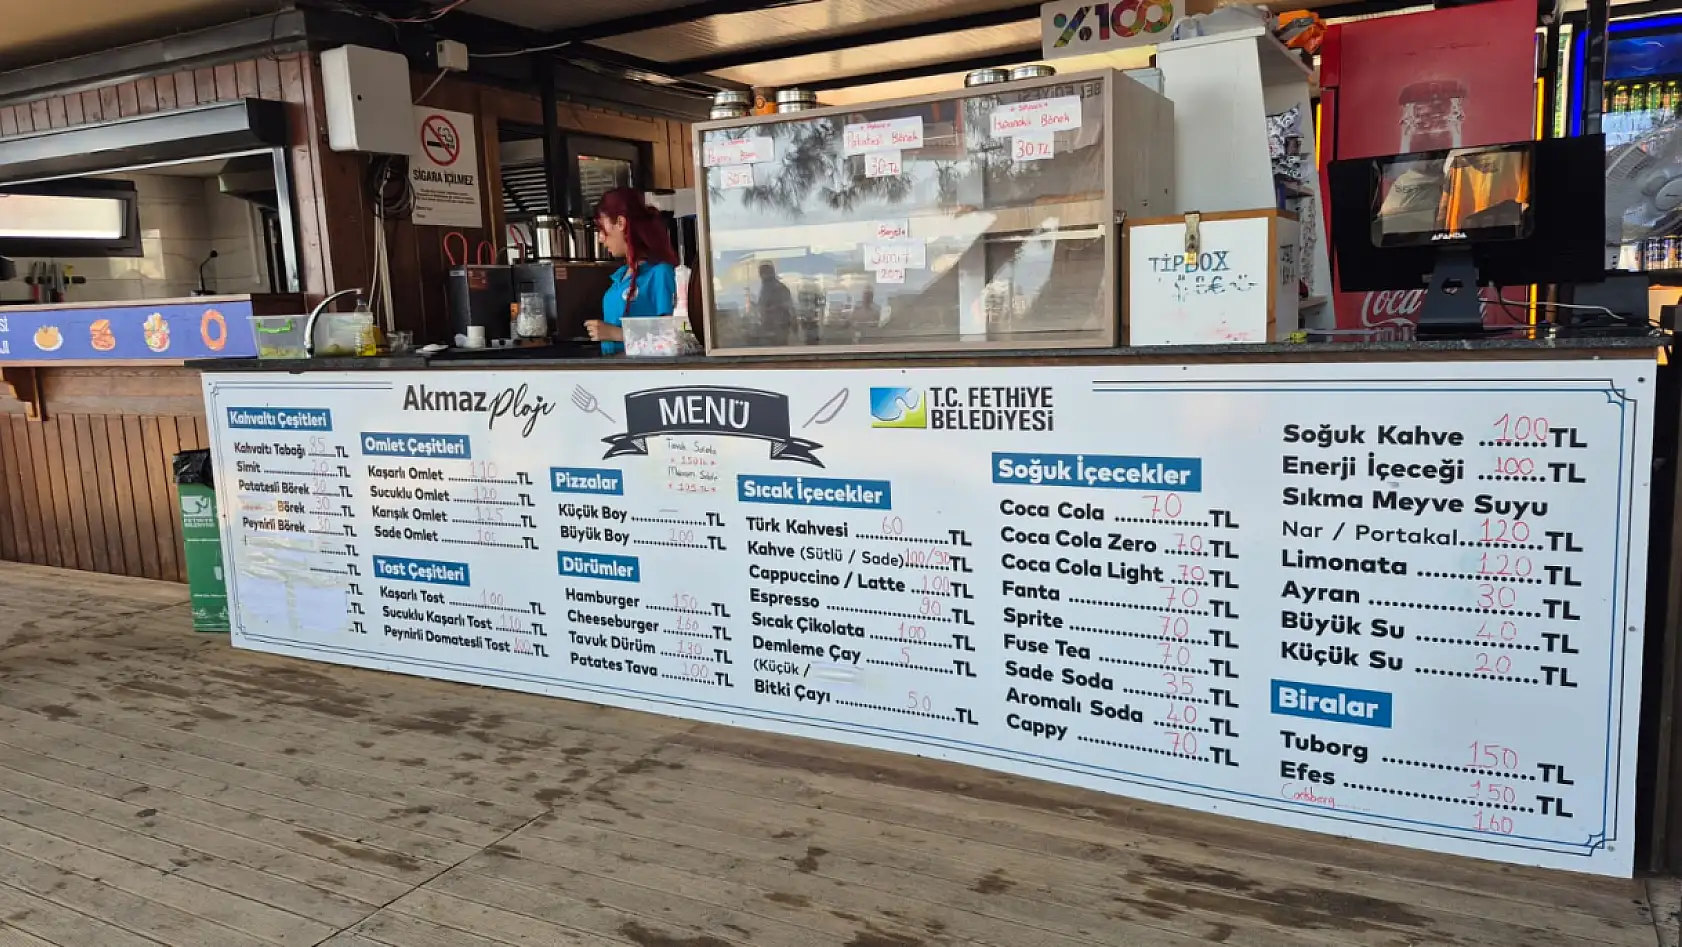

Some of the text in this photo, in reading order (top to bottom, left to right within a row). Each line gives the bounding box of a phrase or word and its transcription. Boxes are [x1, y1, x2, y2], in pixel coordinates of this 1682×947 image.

[1053, 0, 1174, 47] %100
[1017, 139, 1034, 159] 30
[403, 384, 487, 413] Akmaz
[930, 387, 962, 408] T.C.
[230, 410, 327, 429] Kahvaltı Çeşitleri
[658, 395, 750, 429] MENÜ
[1282, 413, 1588, 448] Soğuk Kahve 100 TL
[233, 441, 272, 455] Kahvaltı
[335, 445, 349, 458] TL
[364, 436, 464, 457] Omlet Çeşitleri
[236, 460, 261, 473] Simit
[368, 464, 445, 481] Kaşarlı Omlet
[999, 455, 1191, 486] Soğuk İçecekler
[1281, 451, 1535, 484] Enerji İçeceği 100
[238, 479, 310, 495] Patatesli Börek
[370, 485, 451, 502] Sucuklu Omlet
[555, 471, 619, 491] Pizzalar
[743, 477, 883, 504] Sıcak İçecekler
[277, 500, 305, 514] Börek
[372, 504, 449, 523] Karışık Omlet
[558, 502, 628, 523] Küçük Boy
[999, 493, 1240, 529] Coca Cola 70 TL
[1282, 486, 1549, 520] Sıkma Meyve Suyu
[278, 519, 306, 533] Börek
[374, 525, 440, 542] Sade Omlet
[560, 525, 631, 546] Büyük Boy
[746, 515, 973, 547] Türk Kahvesi 60 TL
[1000, 525, 1203, 553] Coca Cola Zero 70
[1282, 518, 1530, 546] Nar Portakal 120
[345, 543, 360, 557] TL
[747, 540, 796, 557] Kahve
[800, 546, 843, 562] (Sütlü
[861, 551, 905, 568] Sade)
[1281, 549, 1533, 577] Limonata 120
[376, 559, 464, 582] Tost Çeşitleri
[562, 556, 634, 578] Dürümler
[749, 564, 841, 585] Cappuccino
[857, 573, 906, 593] Latte
[1001, 553, 1205, 585] Coca Cola Light 70
[380, 585, 547, 616] Kaşarlı Tost TL
[565, 587, 641, 609] Hamburger
[749, 588, 820, 608] Espresso
[1002, 580, 1200, 609] Fanta 70
[1281, 580, 1516, 608] Ayran 30
[382, 605, 493, 631] Sucuklu Kaşarlı Tost
[567, 609, 660, 635] Cheeseburger
[751, 612, 794, 630] Sıcak
[796, 616, 866, 638] Çikolata
[1003, 606, 1190, 639] Sprite 70
[1281, 609, 1518, 641] Büyük Su 40
[384, 624, 511, 653] Peynirli Domatesli Tost
[568, 630, 656, 654] Tavuk Dürüm
[752, 635, 825, 658] Demleme
[829, 644, 862, 665] Çay
[1003, 633, 1191, 666] Fuse Tea 70
[570, 652, 658, 677] Patates Tava
[753, 657, 800, 676] (Küçük
[1281, 640, 1512, 674] Küçük Su 20
[754, 678, 791, 697] Bitki
[793, 684, 831, 705] Çayı
[1005, 660, 1240, 708] Sade Soda 35 TL
[1006, 687, 1198, 724] Aromalı Soda 40
[1278, 685, 1379, 719] Biralar
[1006, 713, 1198, 756] Cappy 70
[1280, 730, 1575, 786] Tuborg 150 TL
[1280, 759, 1336, 786] Efes
